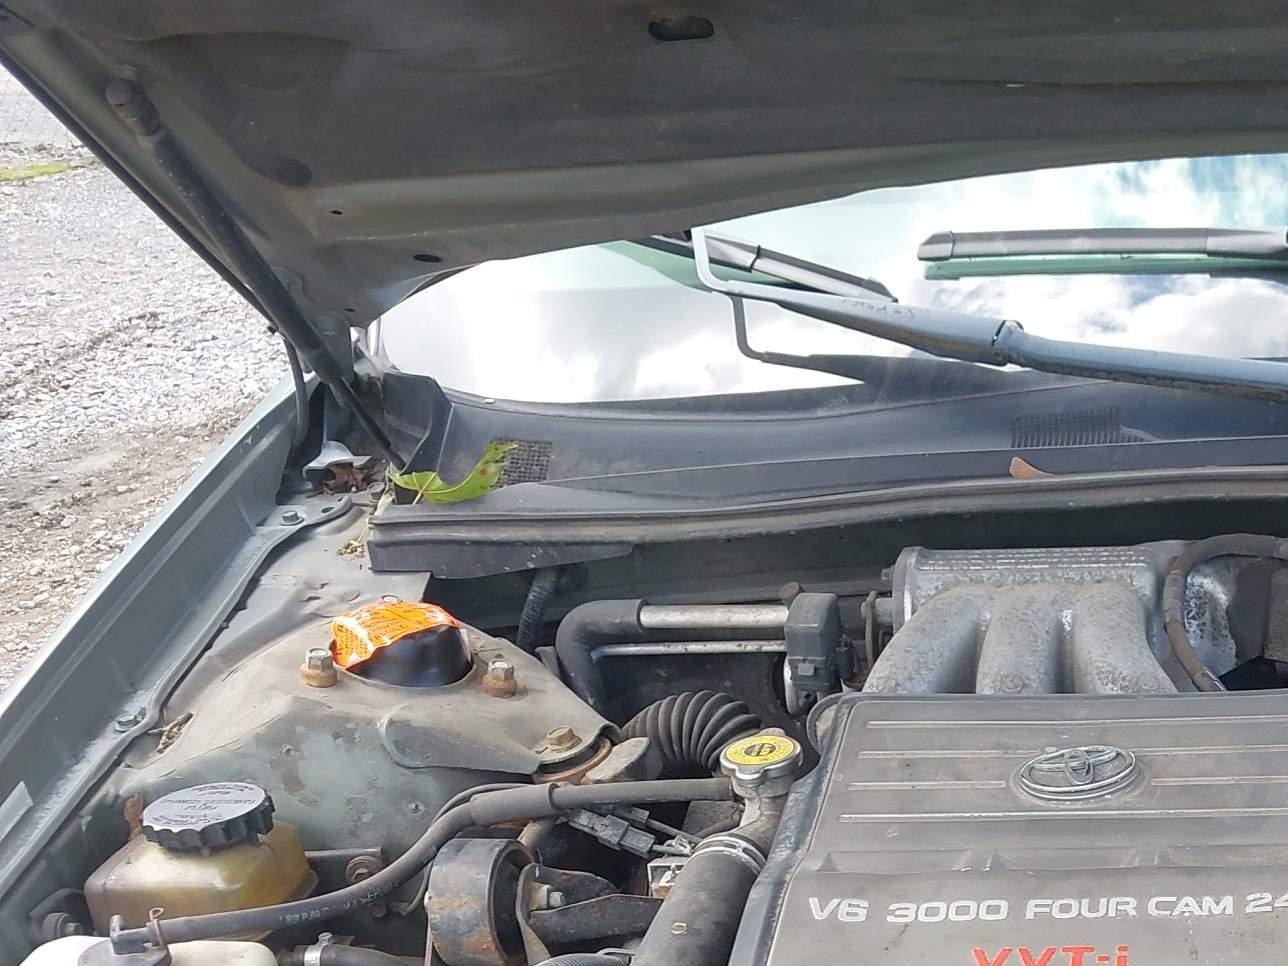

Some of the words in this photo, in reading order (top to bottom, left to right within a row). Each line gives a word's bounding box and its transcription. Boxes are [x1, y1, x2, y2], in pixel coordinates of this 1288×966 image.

[808, 896, 868, 922] V6
[886, 898, 1008, 922] 3000
[1025, 896, 1138, 919] FOUR
[1147, 895, 1234, 917] CAM
